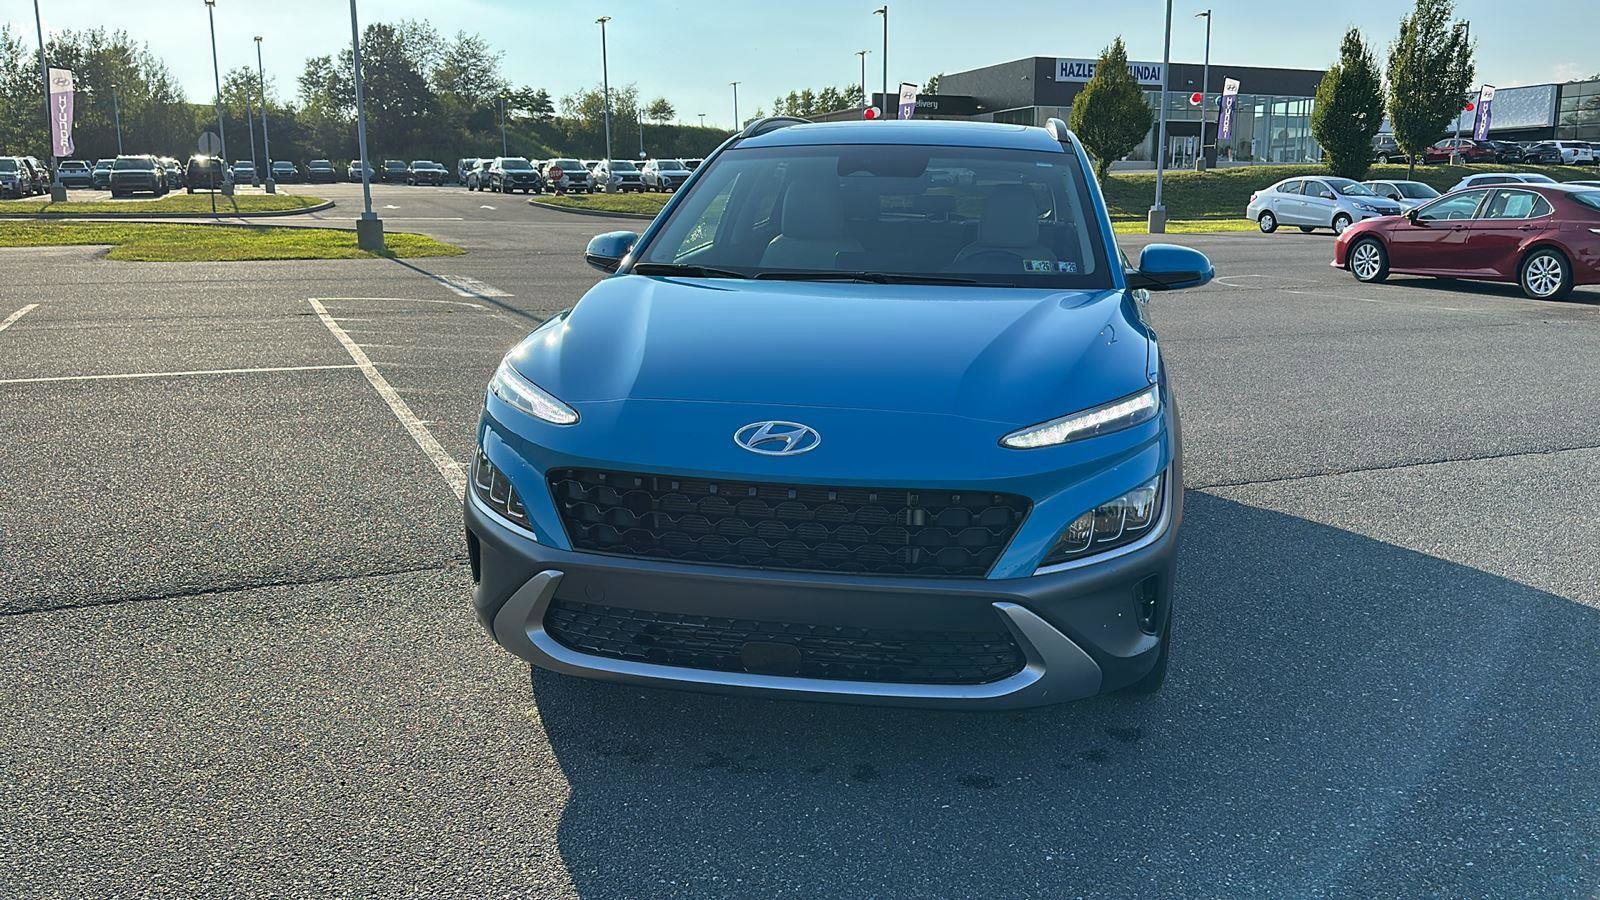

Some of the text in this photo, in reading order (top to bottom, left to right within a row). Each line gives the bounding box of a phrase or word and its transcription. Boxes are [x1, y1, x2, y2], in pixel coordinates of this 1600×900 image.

[1128, 66, 1161, 81] UNDAI
[915, 100, 939, 110] elivery
[1223, 97, 1233, 139] HYUNDAI
[57, 96, 70, 156] HYUNDAI
